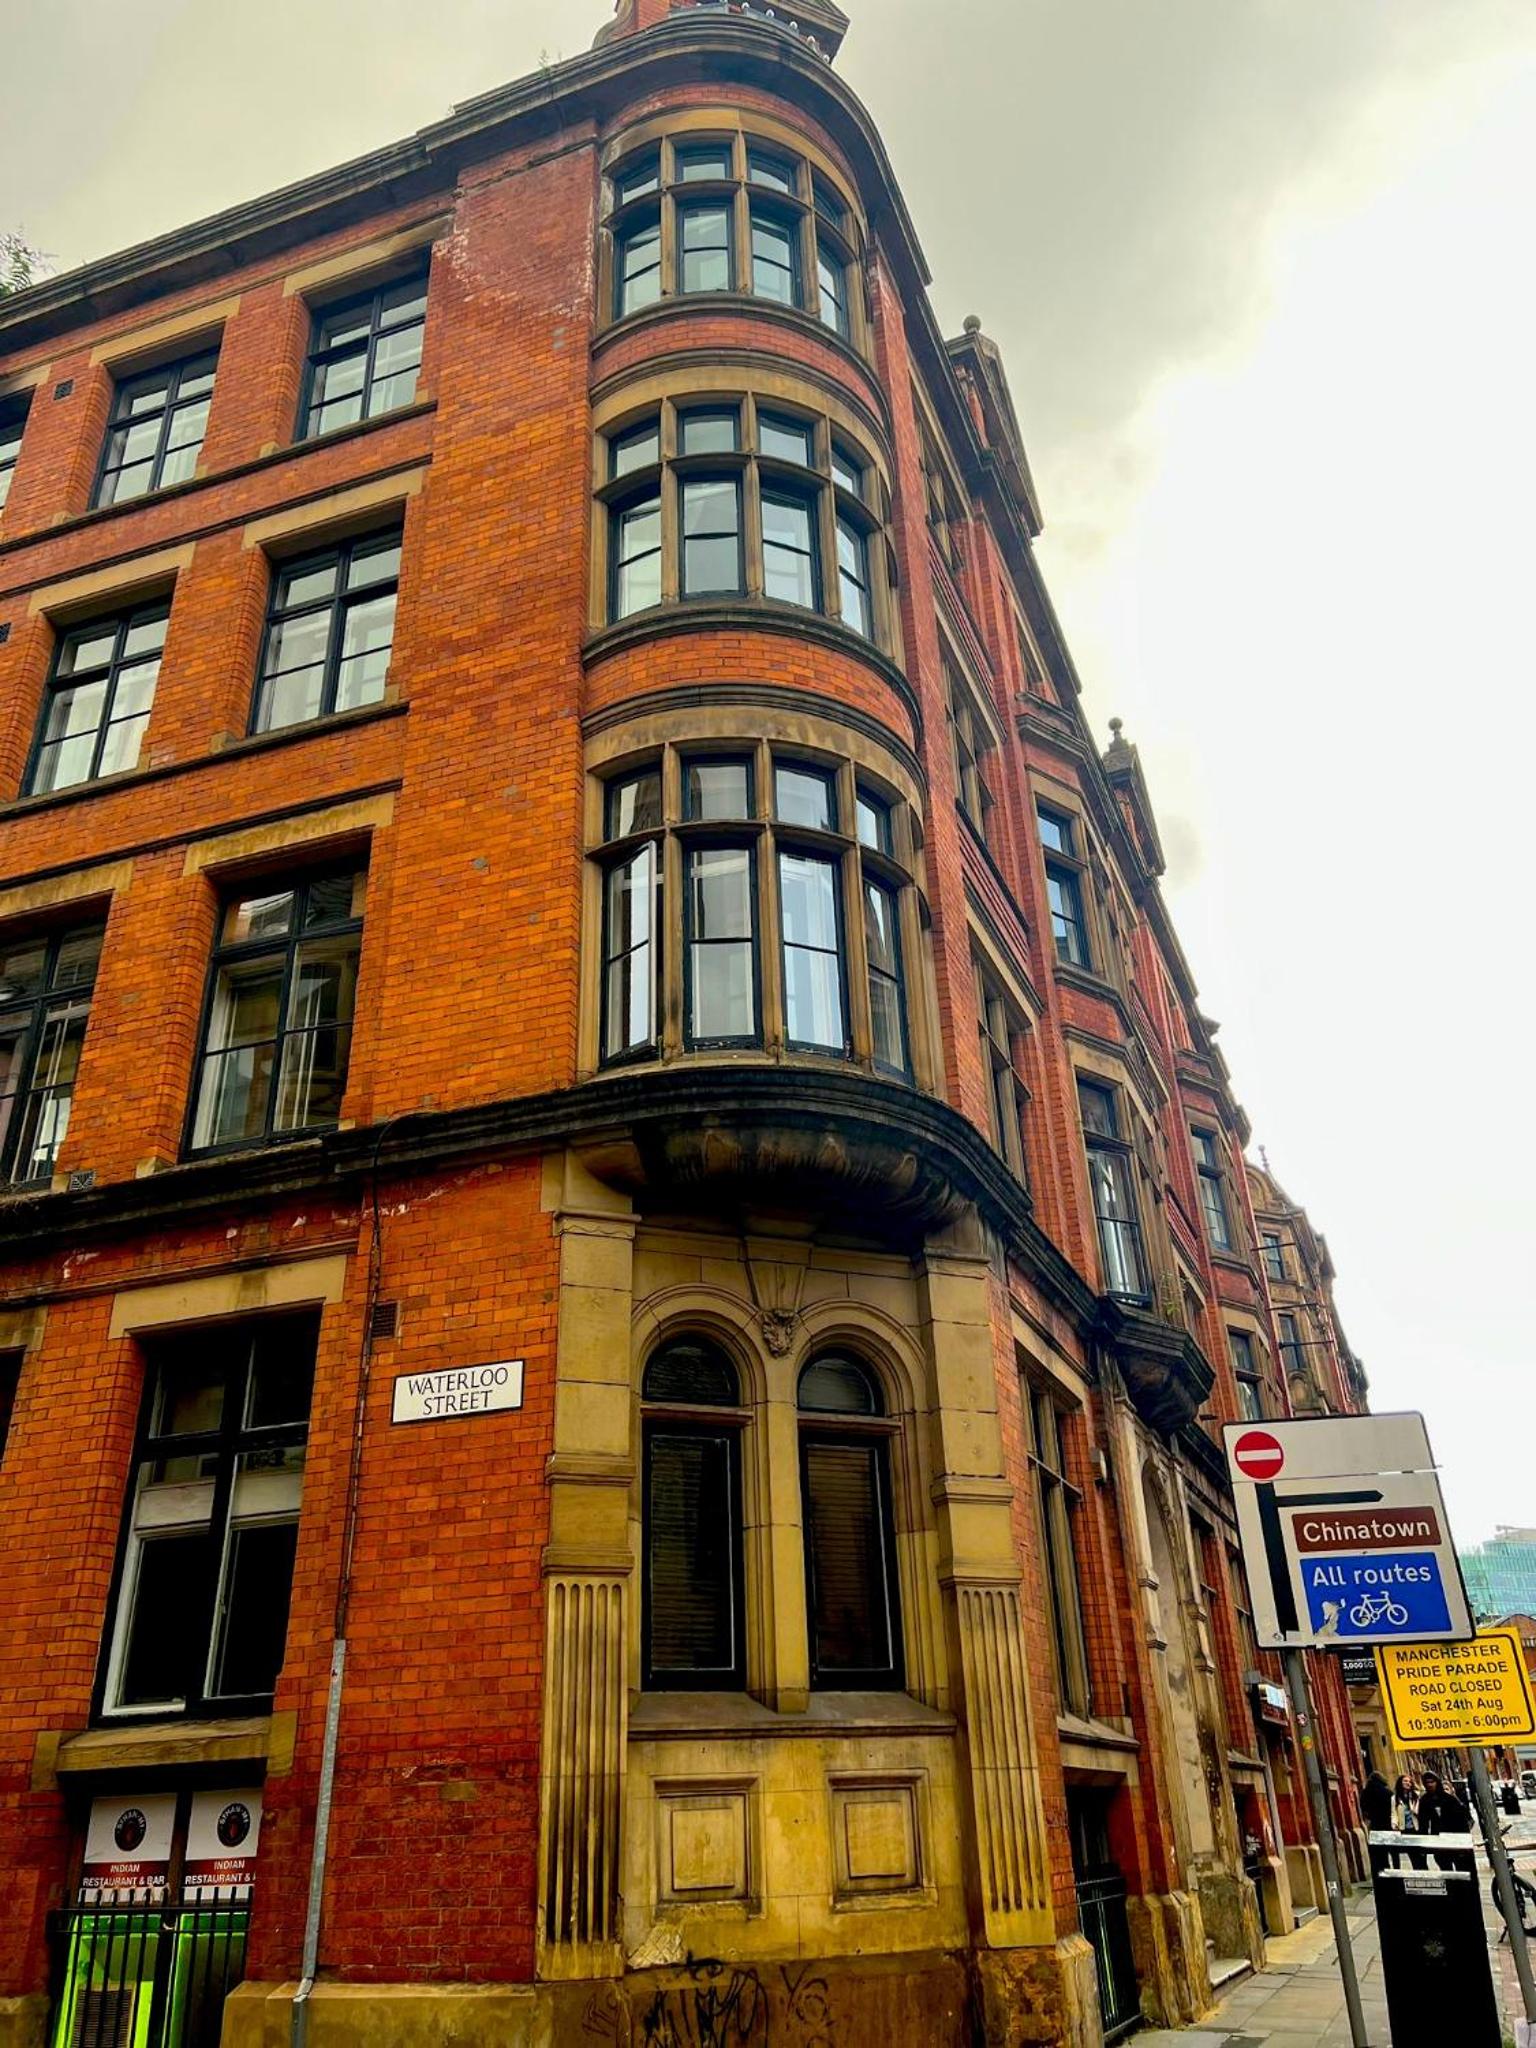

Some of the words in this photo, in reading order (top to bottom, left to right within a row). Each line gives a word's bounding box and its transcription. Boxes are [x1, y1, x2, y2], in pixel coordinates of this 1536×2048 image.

[408, 1367, 508, 1396] WATERLOO
[423, 1390, 493, 1416] STREET
[1303, 1521, 1430, 1541] Chinatown
[1313, 1565, 1346, 1586] All
[1354, 1563, 1431, 1584] routes
[1396, 1645, 1501, 1662] MANCHESTER
[1396, 1666, 1441, 1679] PRIDE
[1445, 1661, 1508, 1676] PARADE
[1410, 1683, 1446, 1695] ROAD
[1450, 1679, 1503, 1692] CLOSED
[1421, 1701, 1442, 1712] Sat
[1445, 1699, 1473, 1710] 24th
[1477, 1698, 1504, 1710] Aug
[1408, 1718, 1461, 1730] 10:30am
[1473, 1715, 1521, 1728] 6:00pm
[110, 1864, 140, 1873] INDIAN
[214, 1860, 245, 1870] INDIAN
[82, 1876, 138, 1887] RESTAURANT
[139, 1876, 145, 1885] &
[147, 1875, 165, 1885] BAR
[185, 1873, 241, 1885] RESTAURANT
[244, 1872, 251, 1881] &
